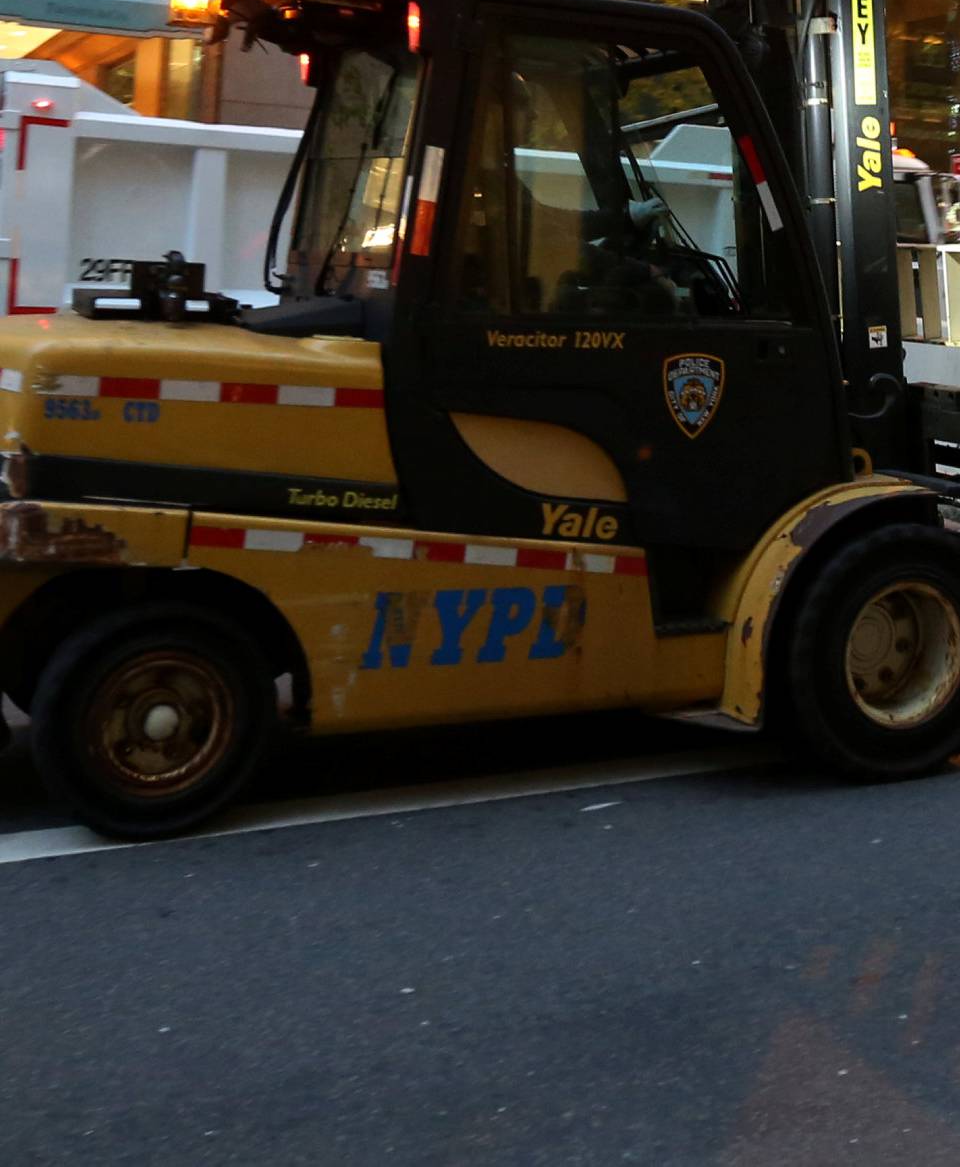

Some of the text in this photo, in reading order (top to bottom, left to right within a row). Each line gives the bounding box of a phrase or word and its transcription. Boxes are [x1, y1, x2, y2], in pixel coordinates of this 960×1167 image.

[856, 116, 882, 192] Yale
[487, 329, 626, 349] Veracitor 120VX
[679, 358, 710, 368] POLICE
[287, 488, 398, 510] Turbo Diesel
[541, 502, 619, 540] Yale
